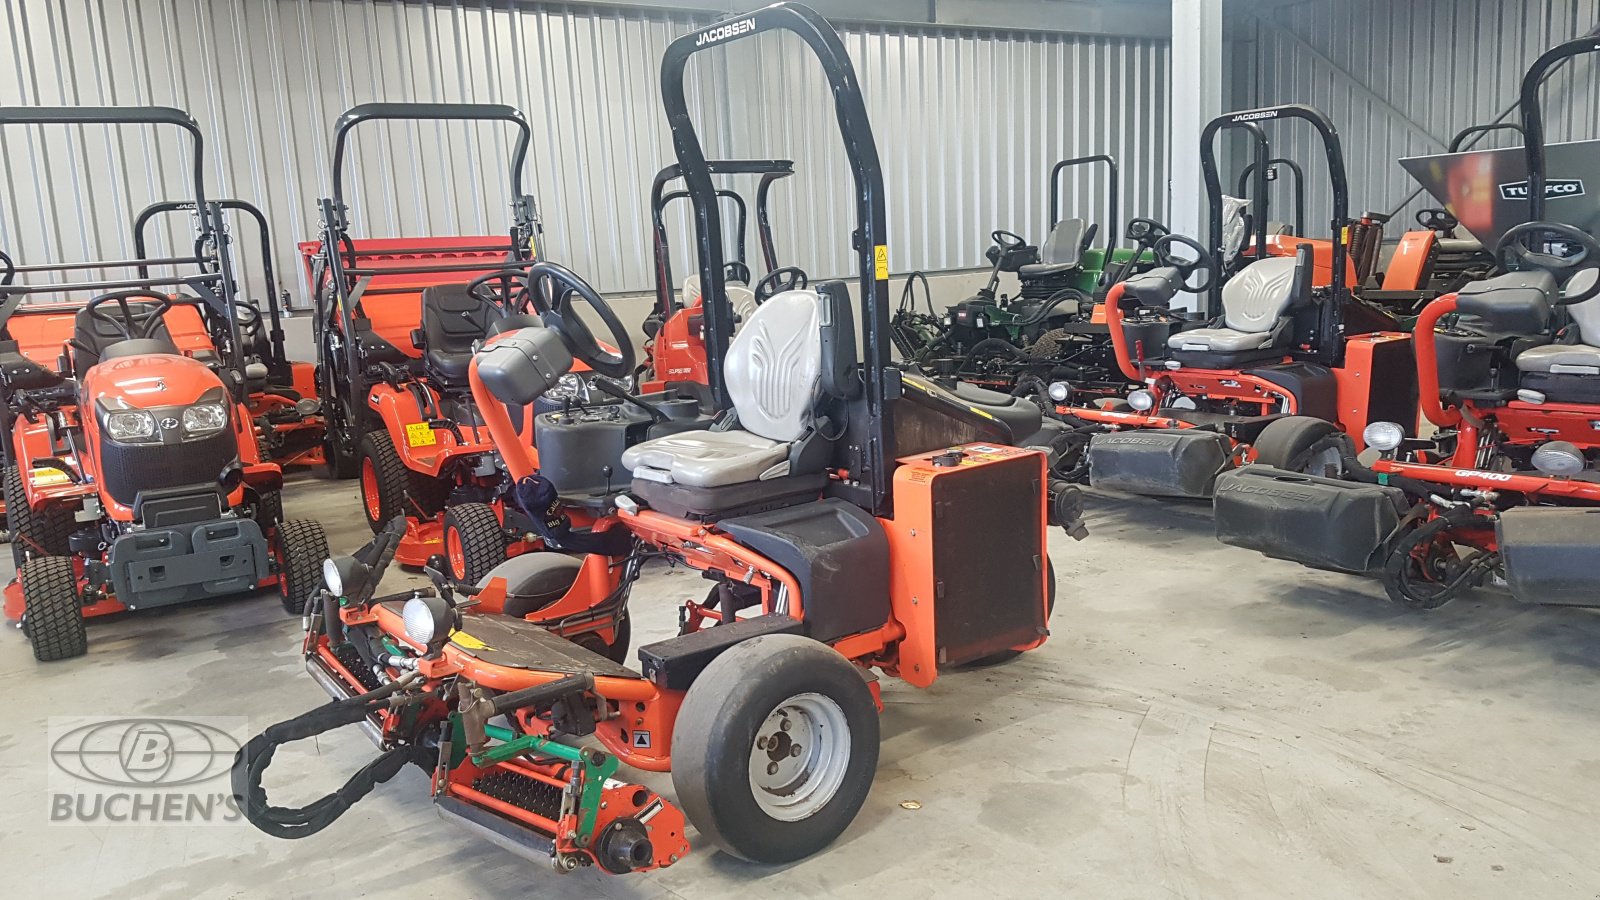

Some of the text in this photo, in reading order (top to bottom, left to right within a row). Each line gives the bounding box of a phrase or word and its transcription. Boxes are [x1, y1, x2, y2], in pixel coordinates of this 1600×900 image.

[695, 17, 756, 46] JACOBSEN
[1231, 110, 1278, 122] JACOBSEN
[1506, 183, 1577, 196] TUFCO
[1094, 437, 1172, 446] JACOBSEN
[1455, 469, 1512, 481] GP400
